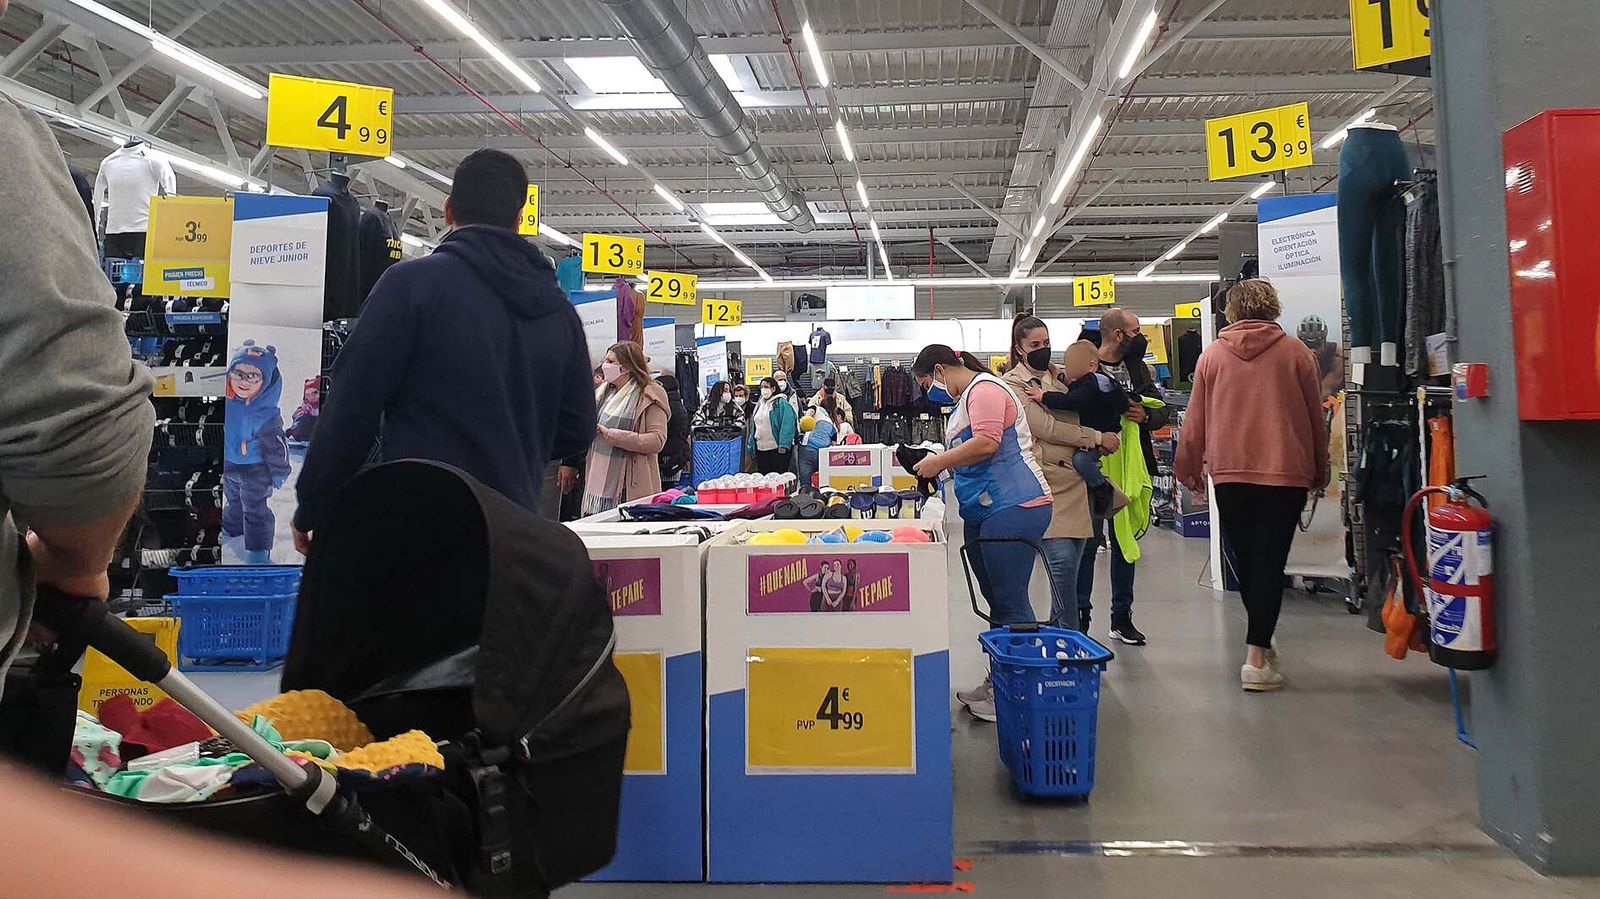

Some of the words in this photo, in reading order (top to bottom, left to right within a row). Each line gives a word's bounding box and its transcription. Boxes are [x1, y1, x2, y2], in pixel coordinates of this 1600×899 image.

[317, 95, 351, 140] 4
[359, 126, 387, 144] 99
[1218, 121, 1277, 168] 13
[1283, 140, 1308, 158] 99
[185, 221, 197, 242] 3
[250, 242, 294, 254] DEPORTES
[295, 241, 307, 251] DE
[589, 241, 624, 268] 13
[627, 258, 642, 270] 99
[250, 255, 276, 266] NIEVE
[277, 252, 309, 263] JUNIOR
[649, 277, 681, 298] 29
[682, 291, 695, 300] 99
[1077, 280, 1101, 302] 15
[1102, 290, 1114, 299] 99
[706, 303, 729, 321] 12
[99, 687, 149, 697] PERSONAS
[816, 686, 843, 730] 4
[797, 720, 816, 730] PVP
[842, 712, 864, 730] 99
